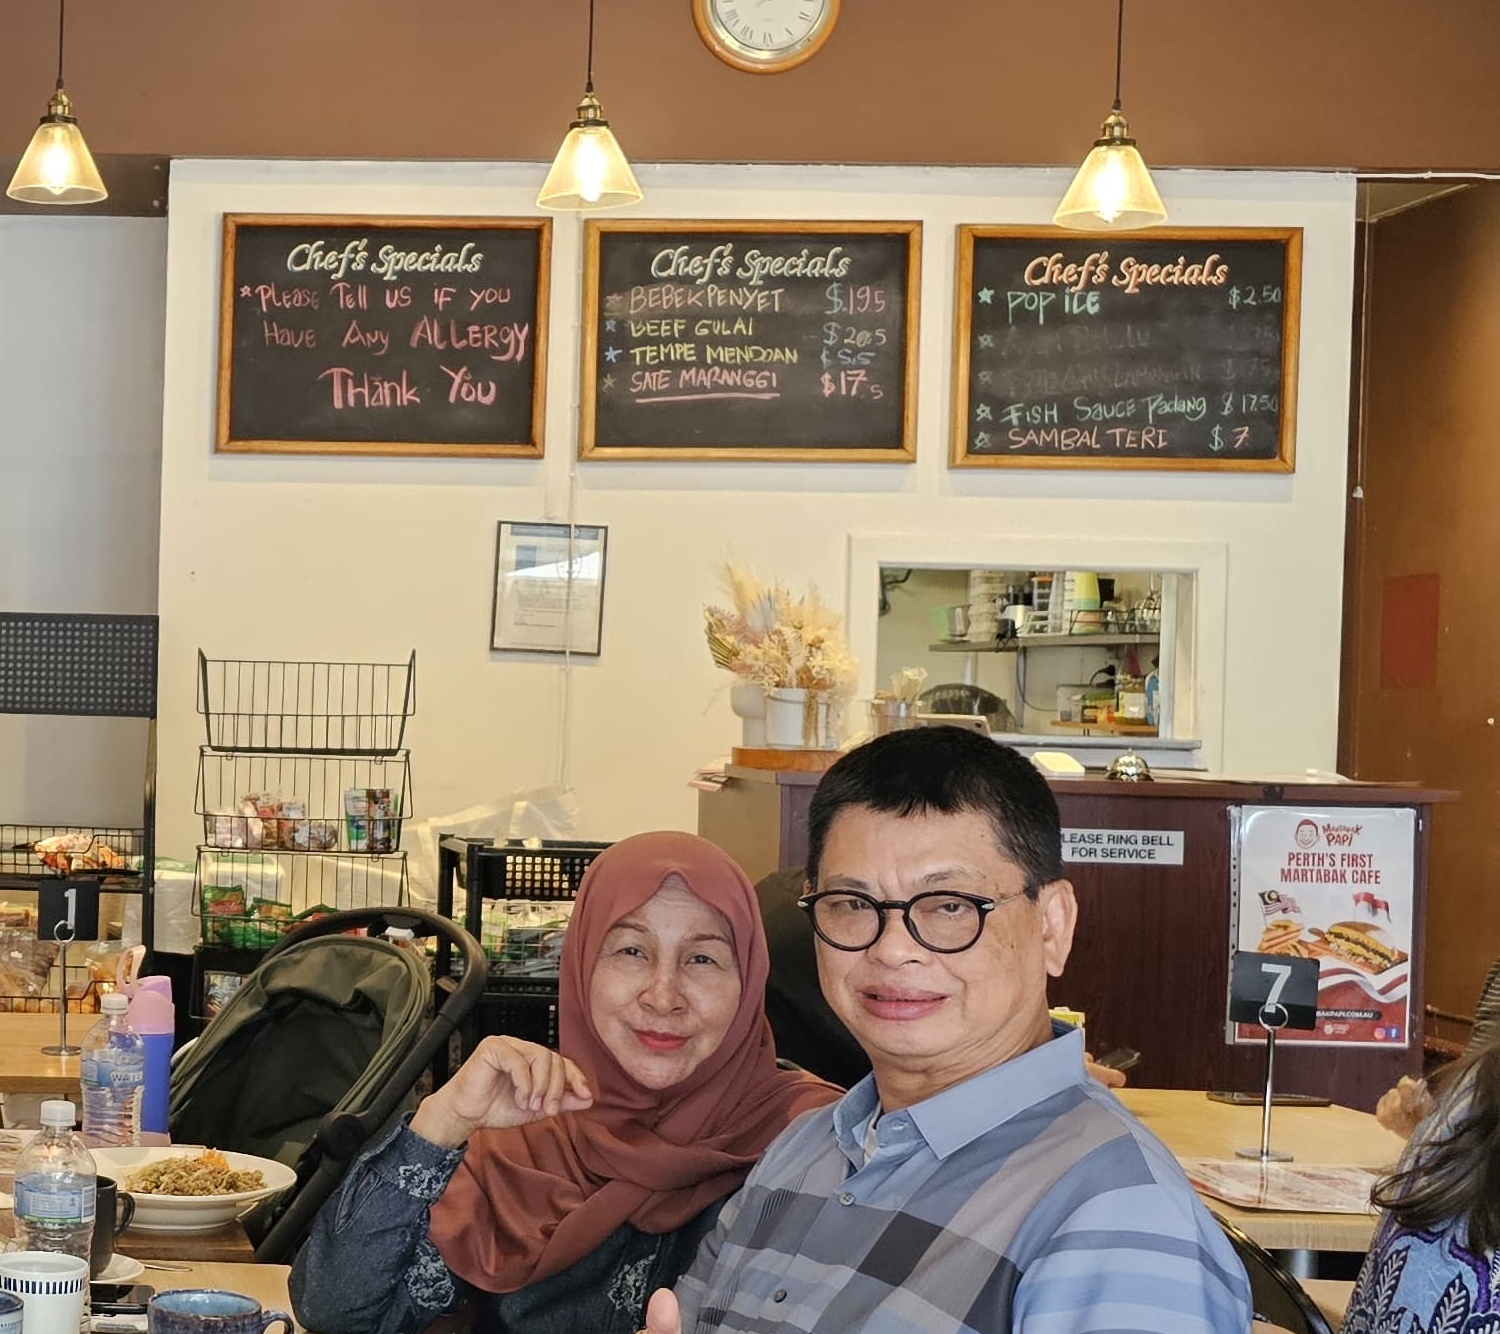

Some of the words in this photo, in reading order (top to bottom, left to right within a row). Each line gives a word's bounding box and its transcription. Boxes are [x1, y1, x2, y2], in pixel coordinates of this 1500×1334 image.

[286, 238, 369, 281] Chef's
[370, 242, 485, 281] Specials
[650, 242, 734, 285] Chef's
[735, 246, 853, 285] Specials
[1023, 250, 1110, 294] Chef's
[1111, 253, 1230, 294] Specials
[629, 285, 704, 315] BEBEK
[706, 283, 785, 313] PENYET
[629, 319, 687, 338] BEEF
[694, 317, 754, 337] GULAI
[629, 343, 697, 366] TEMPE
[705, 345, 799, 365] MENDOAN
[629, 370, 673, 393] SATE
[1008, 425, 1101, 451] SAMBAL
[1106, 426, 1169, 451] TERI
[1061, 832, 1103, 844] LEASE
[1107, 833, 1138, 845] RING
[1141, 835, 1174, 846] BELL
[1071, 846, 1098, 857] FOR
[1100, 847, 1156, 859] SERVICE
[1287, 851, 1337, 867] PERTH'S
[1340, 853, 1374, 868] FIRST
[1280, 868, 1348, 884] MARTABAK
[1351, 869, 1381, 884] CAFE
[64, 888, 77, 930] 1
[1261, 963, 1292, 1013] 7
